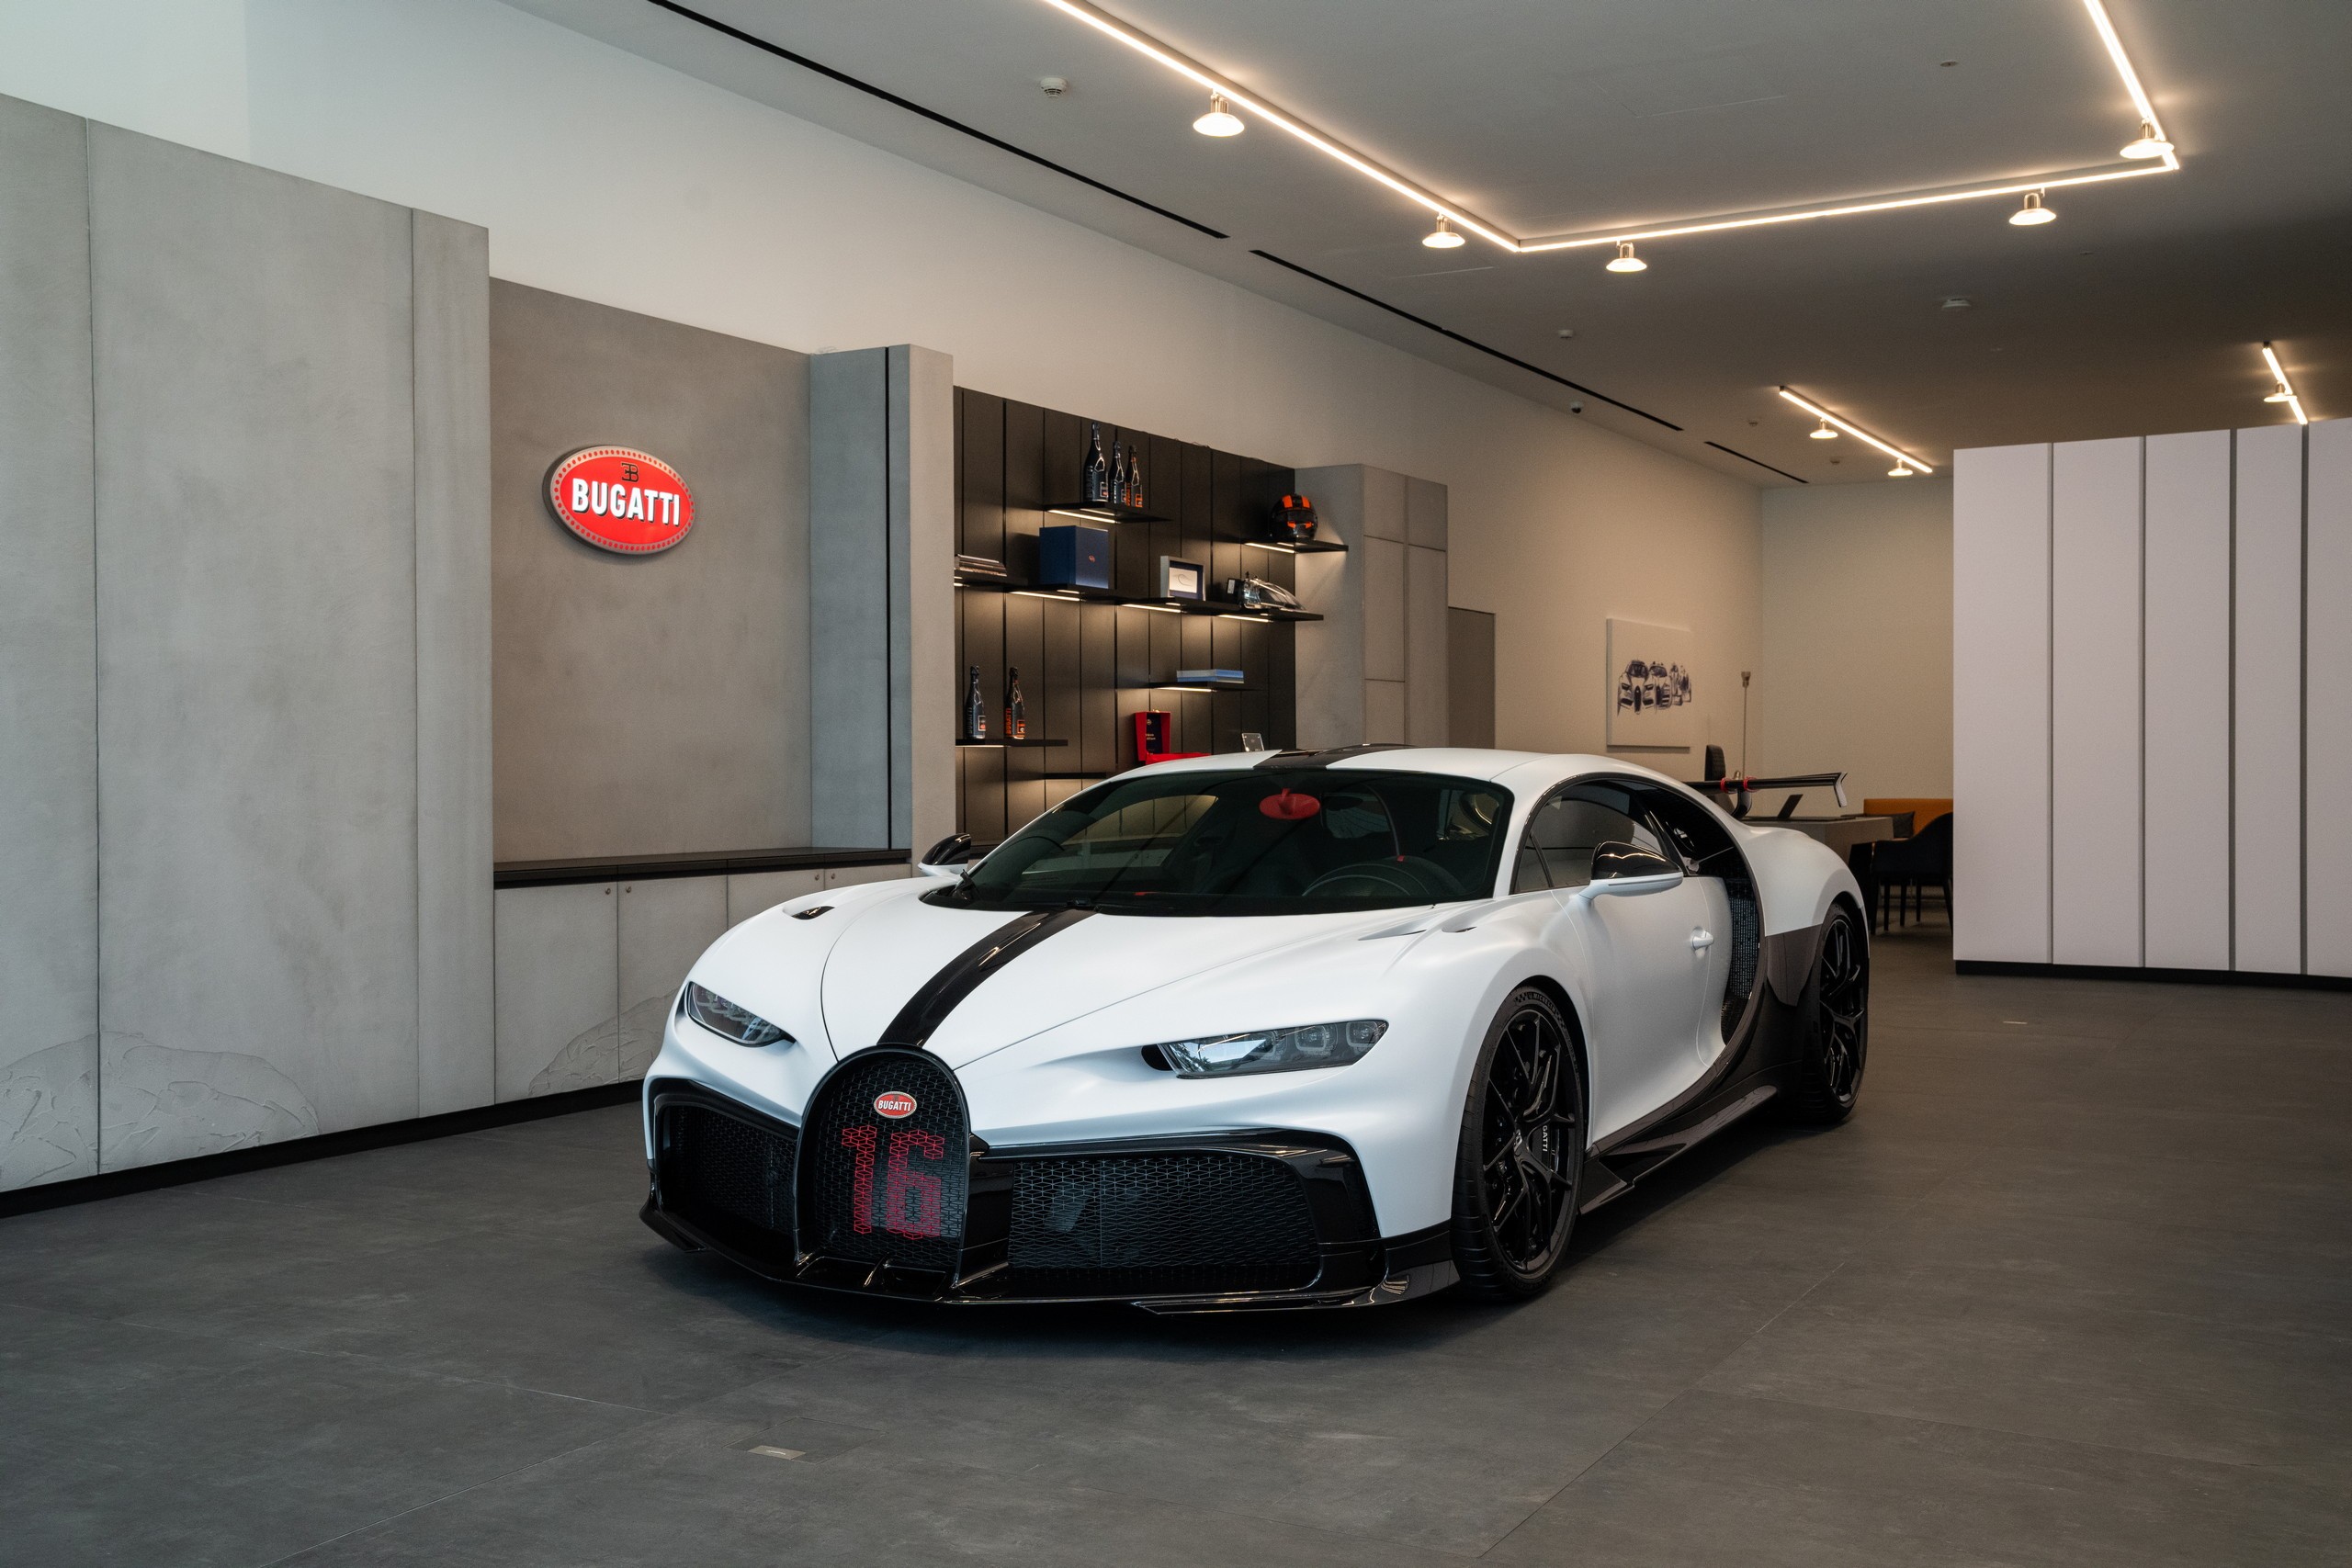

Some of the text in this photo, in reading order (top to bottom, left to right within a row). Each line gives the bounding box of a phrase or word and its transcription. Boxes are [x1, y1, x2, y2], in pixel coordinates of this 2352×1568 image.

[571, 478, 681, 527] BUGATTI
[877, 1100, 912, 1112] BUGATTI
[841, 1125, 945, 1240] 16
